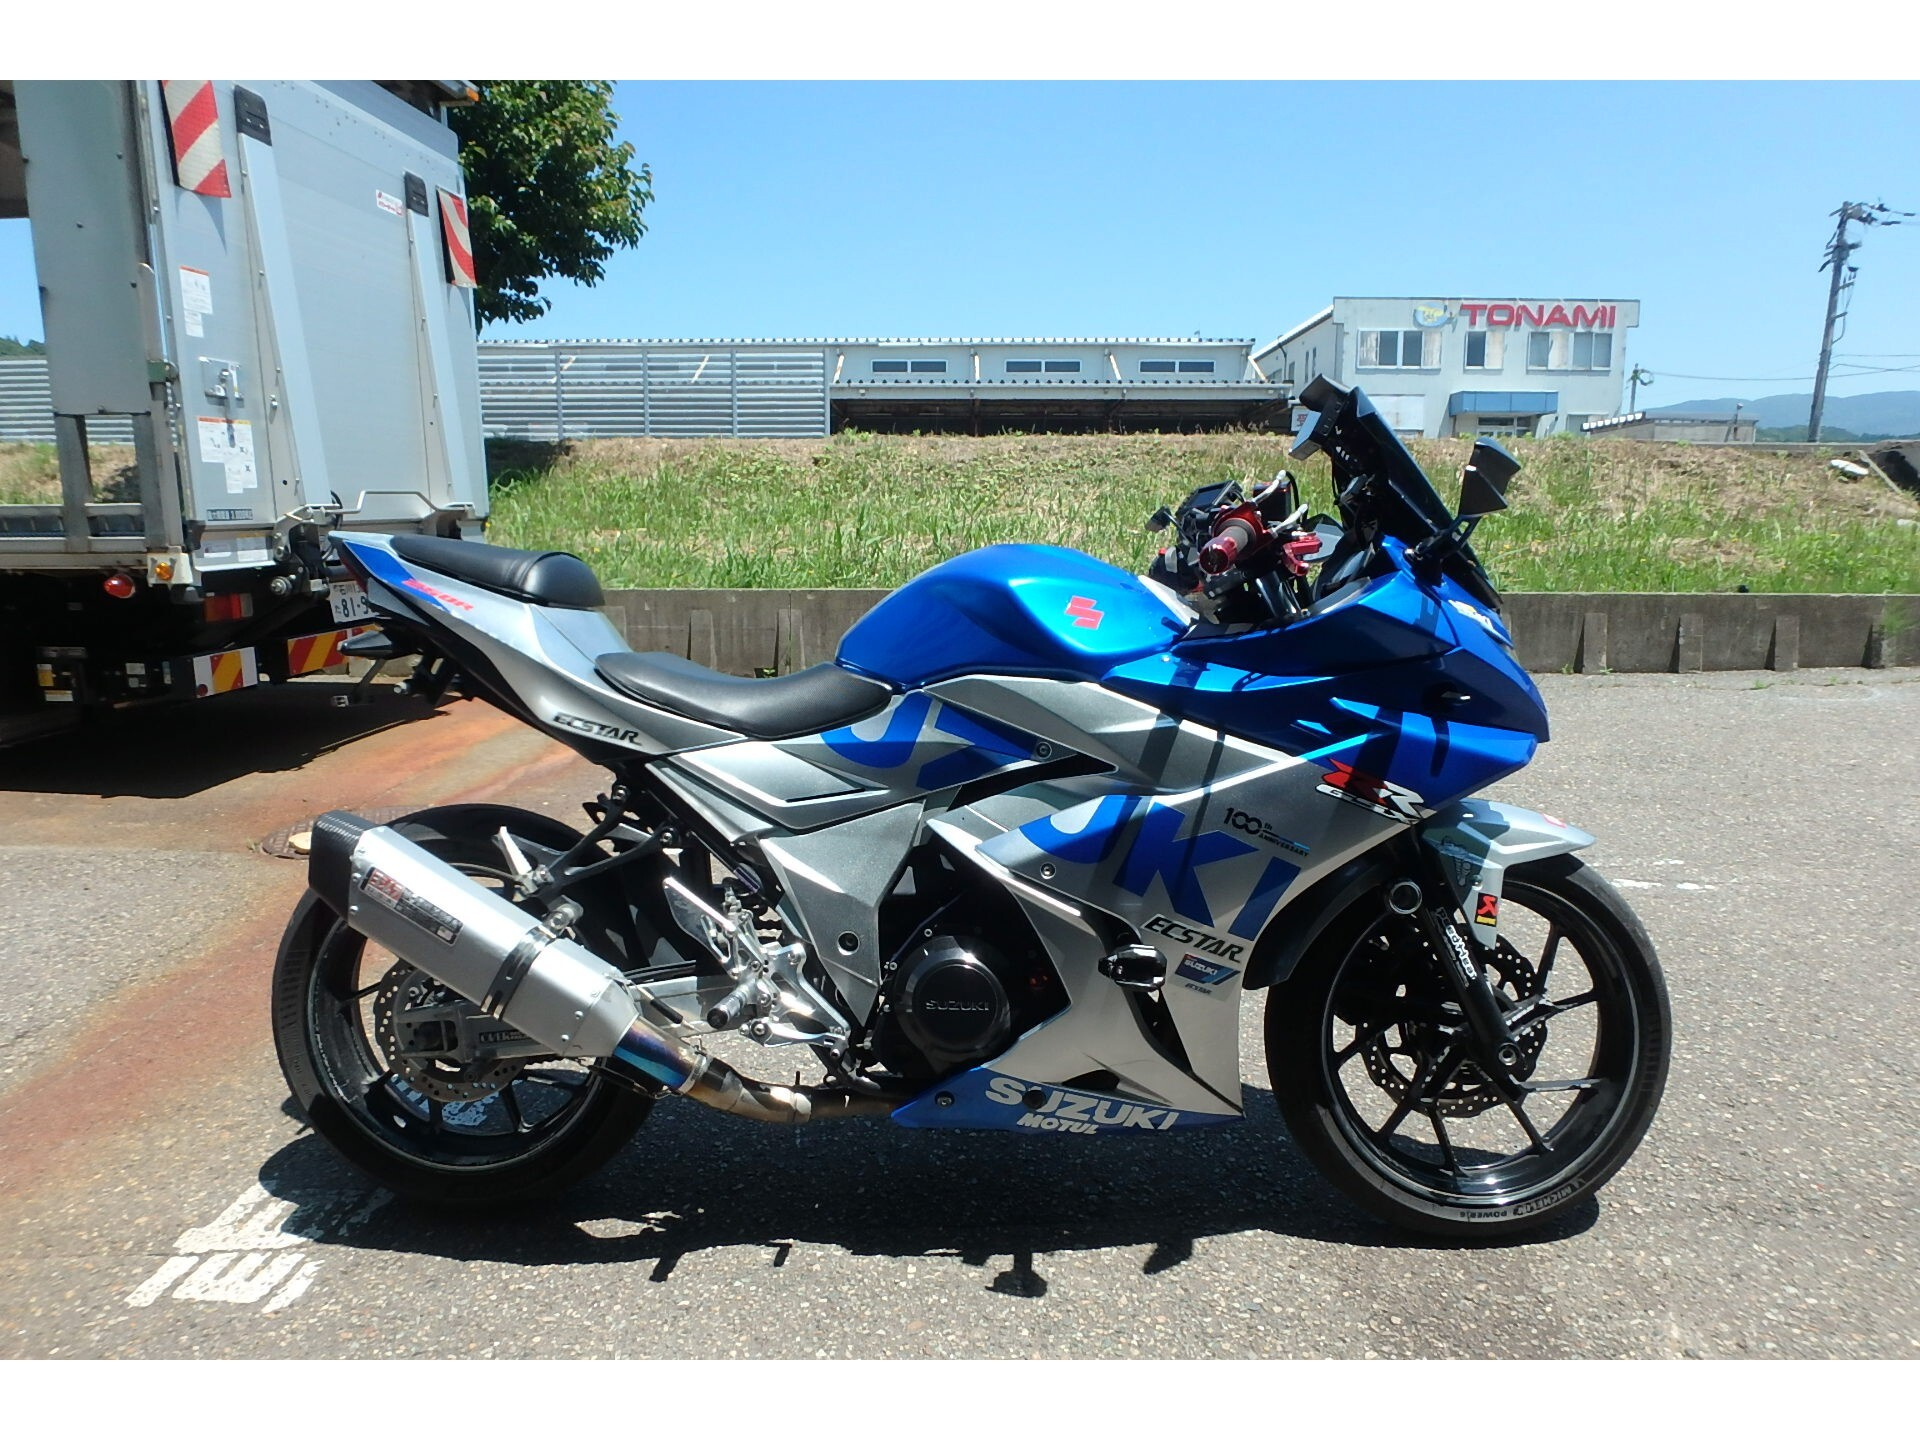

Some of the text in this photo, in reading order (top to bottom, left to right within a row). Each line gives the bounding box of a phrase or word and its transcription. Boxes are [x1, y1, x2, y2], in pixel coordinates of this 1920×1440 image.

[1460, 304, 1616, 327] TONAMI
[553, 712, 642, 746] ECSTAR
[1144, 916, 1244, 964] ECSTAR
[1184, 959, 1218, 976] SUZUKI
[926, 1000, 989, 1011] SUZUKI
[1016, 1112, 1100, 1135] MOTUL
[1515, 1185, 1573, 1216] MICHELIN
